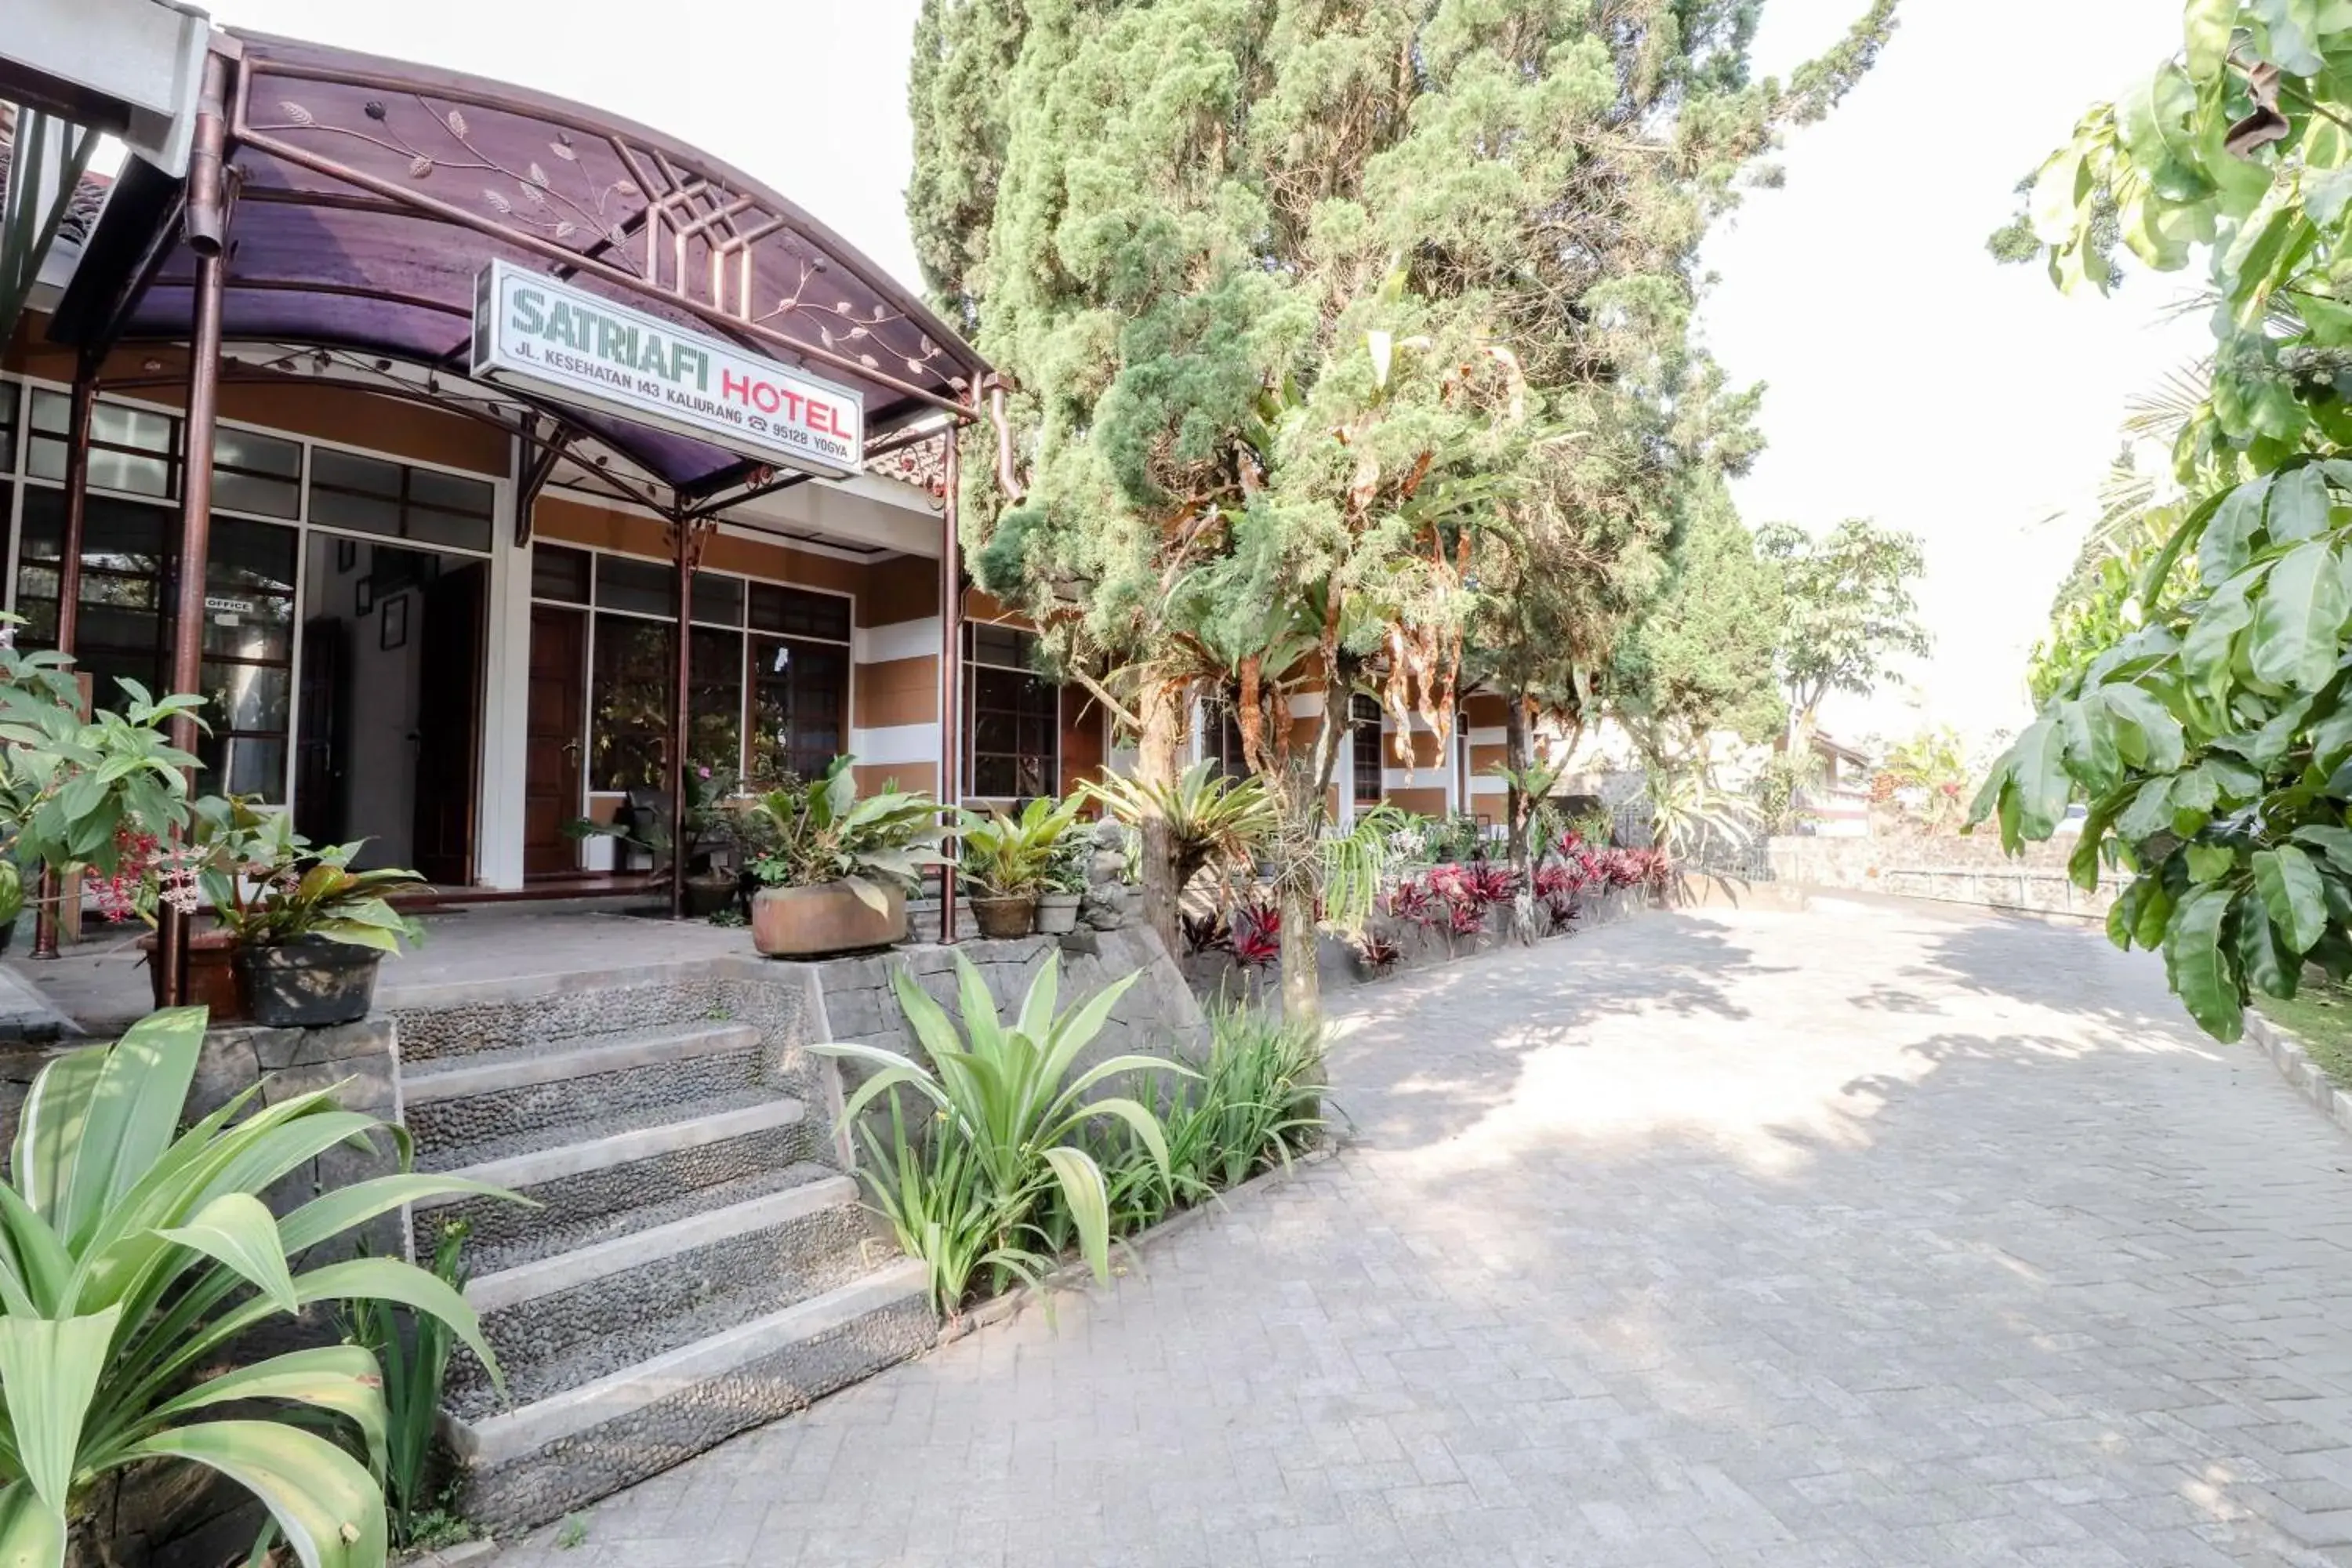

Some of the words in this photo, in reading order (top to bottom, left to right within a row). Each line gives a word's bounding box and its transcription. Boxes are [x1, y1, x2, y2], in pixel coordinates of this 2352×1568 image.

[512, 288, 709, 392] SATRIAFI
[721, 368, 852, 441] HOTEL
[515, 341, 539, 360] JL.
[545, 349, 632, 390] KESEHATAN
[637, 377, 660, 398] 143
[666, 388, 742, 424] KALIURANG
[773, 423, 808, 445] 95128
[813, 435, 848, 459] YOGYA
